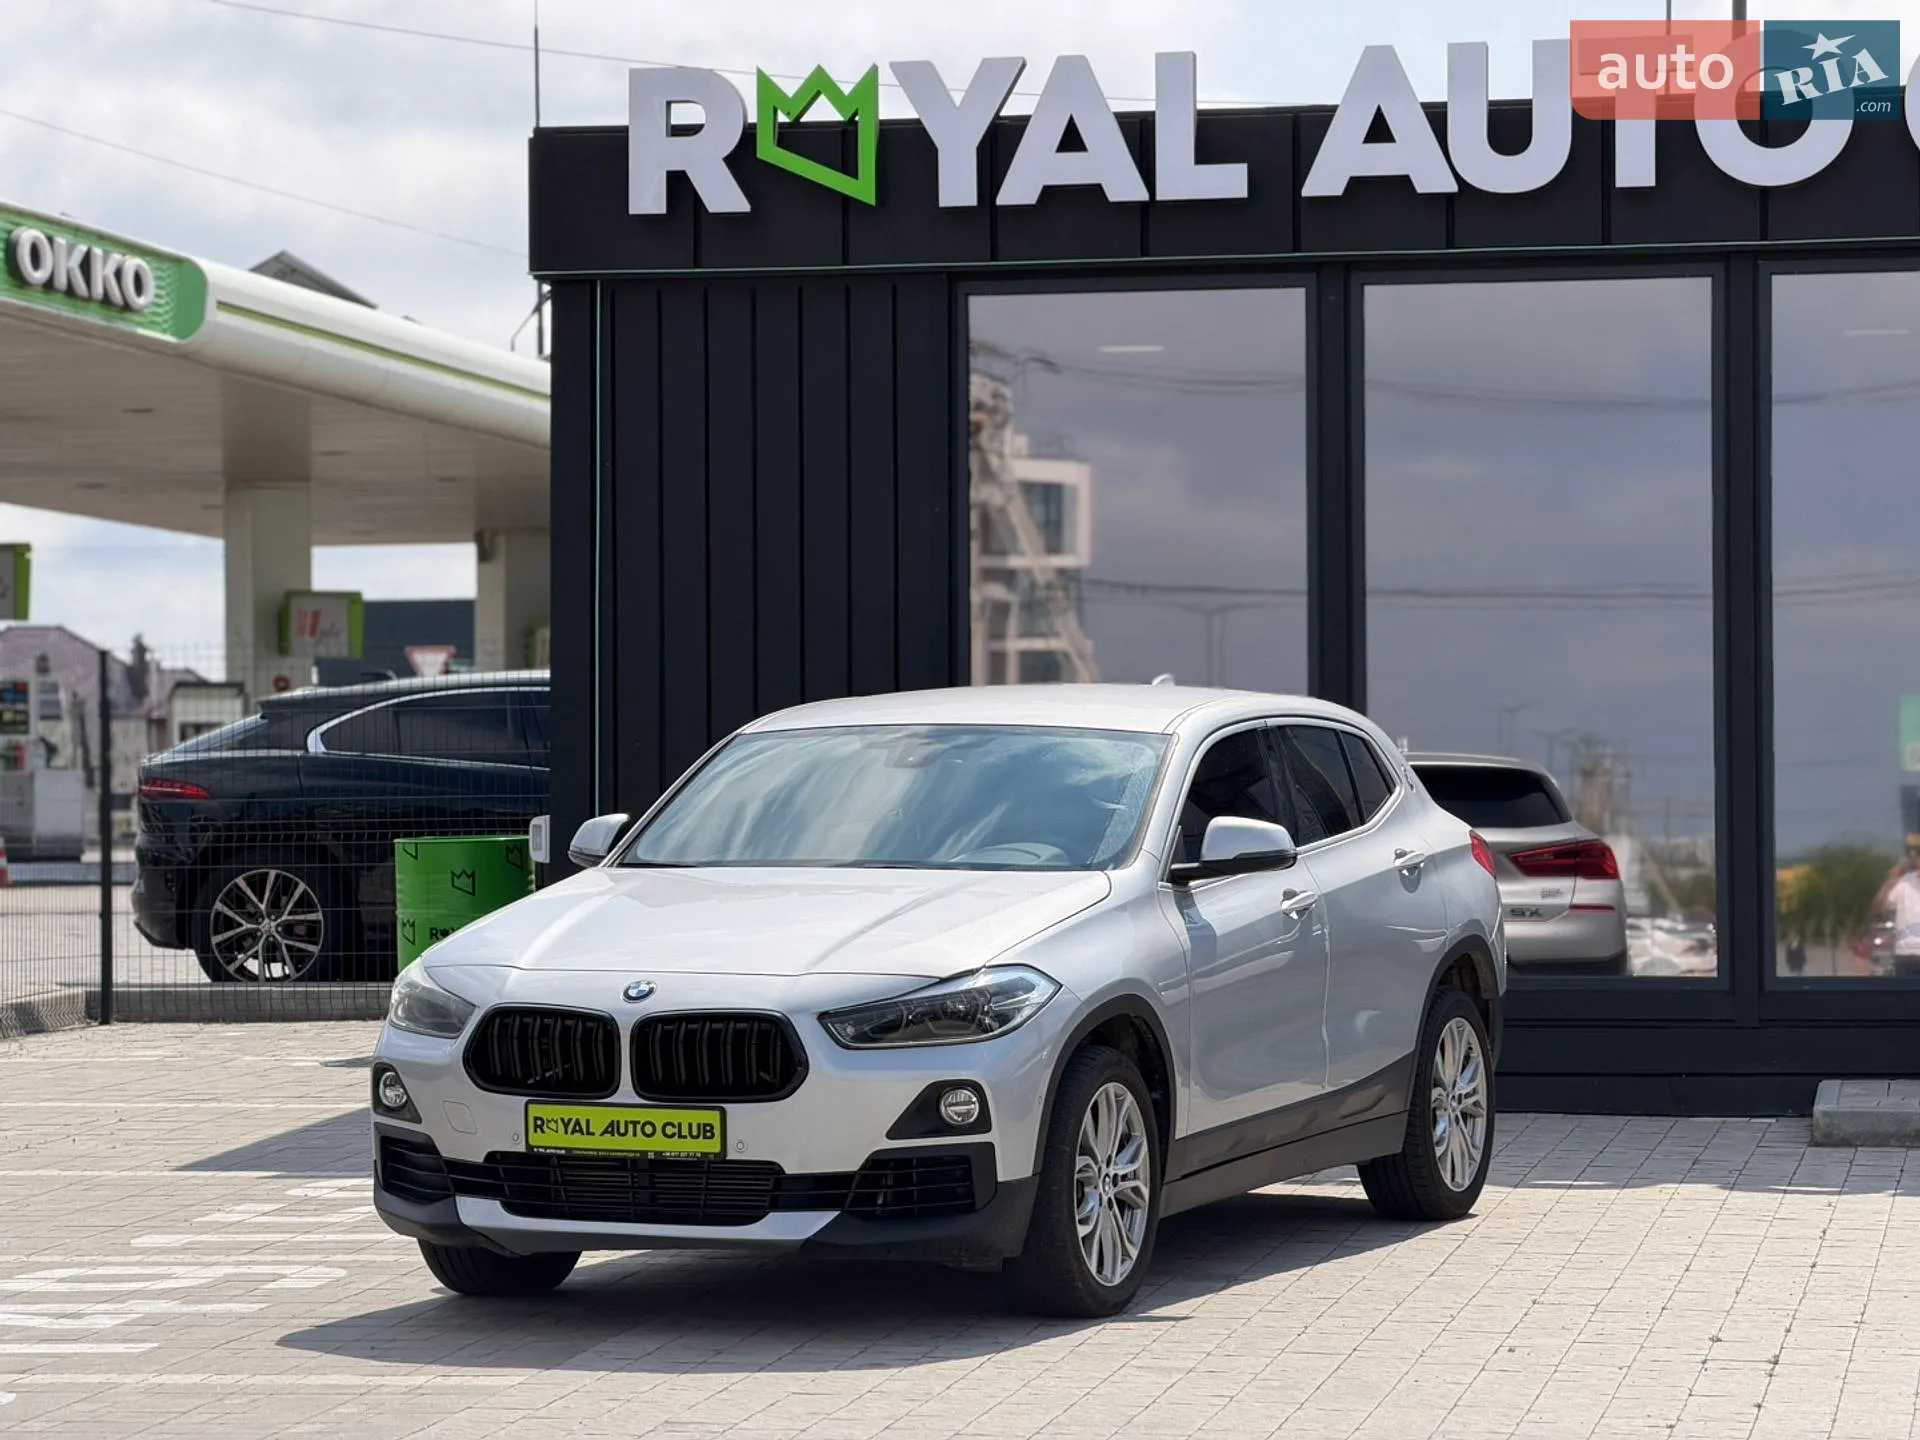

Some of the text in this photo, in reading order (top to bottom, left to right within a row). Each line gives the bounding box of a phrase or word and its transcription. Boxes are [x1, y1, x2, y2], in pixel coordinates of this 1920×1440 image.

[1301, 30, 1854, 197] AUTO
[11, 226, 156, 311] OKKO
[598, 1118, 658, 1139] AUTO
[661, 1121, 716, 1141] CLUB
